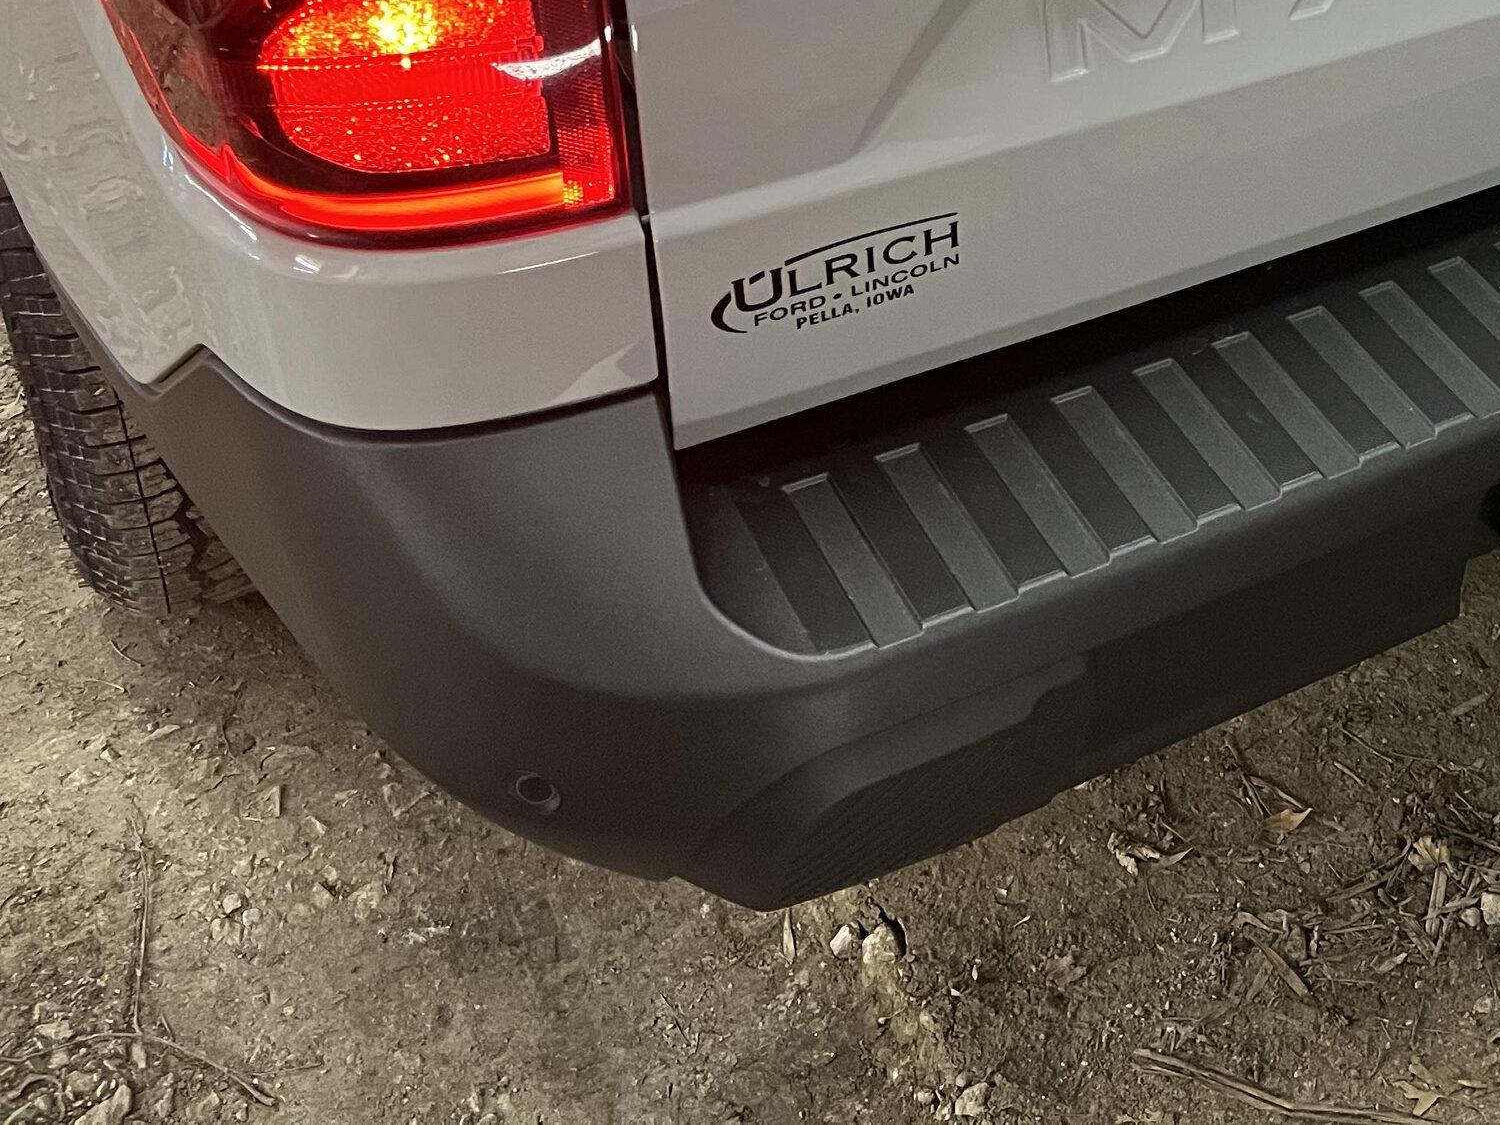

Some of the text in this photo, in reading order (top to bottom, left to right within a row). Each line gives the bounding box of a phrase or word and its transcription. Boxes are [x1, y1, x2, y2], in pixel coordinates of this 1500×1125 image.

[730, 220, 960, 313] ULRICH
[754, 253, 960, 326] FORD LINCOLN
[796, 284, 915, 329] PELLA, IOWA
